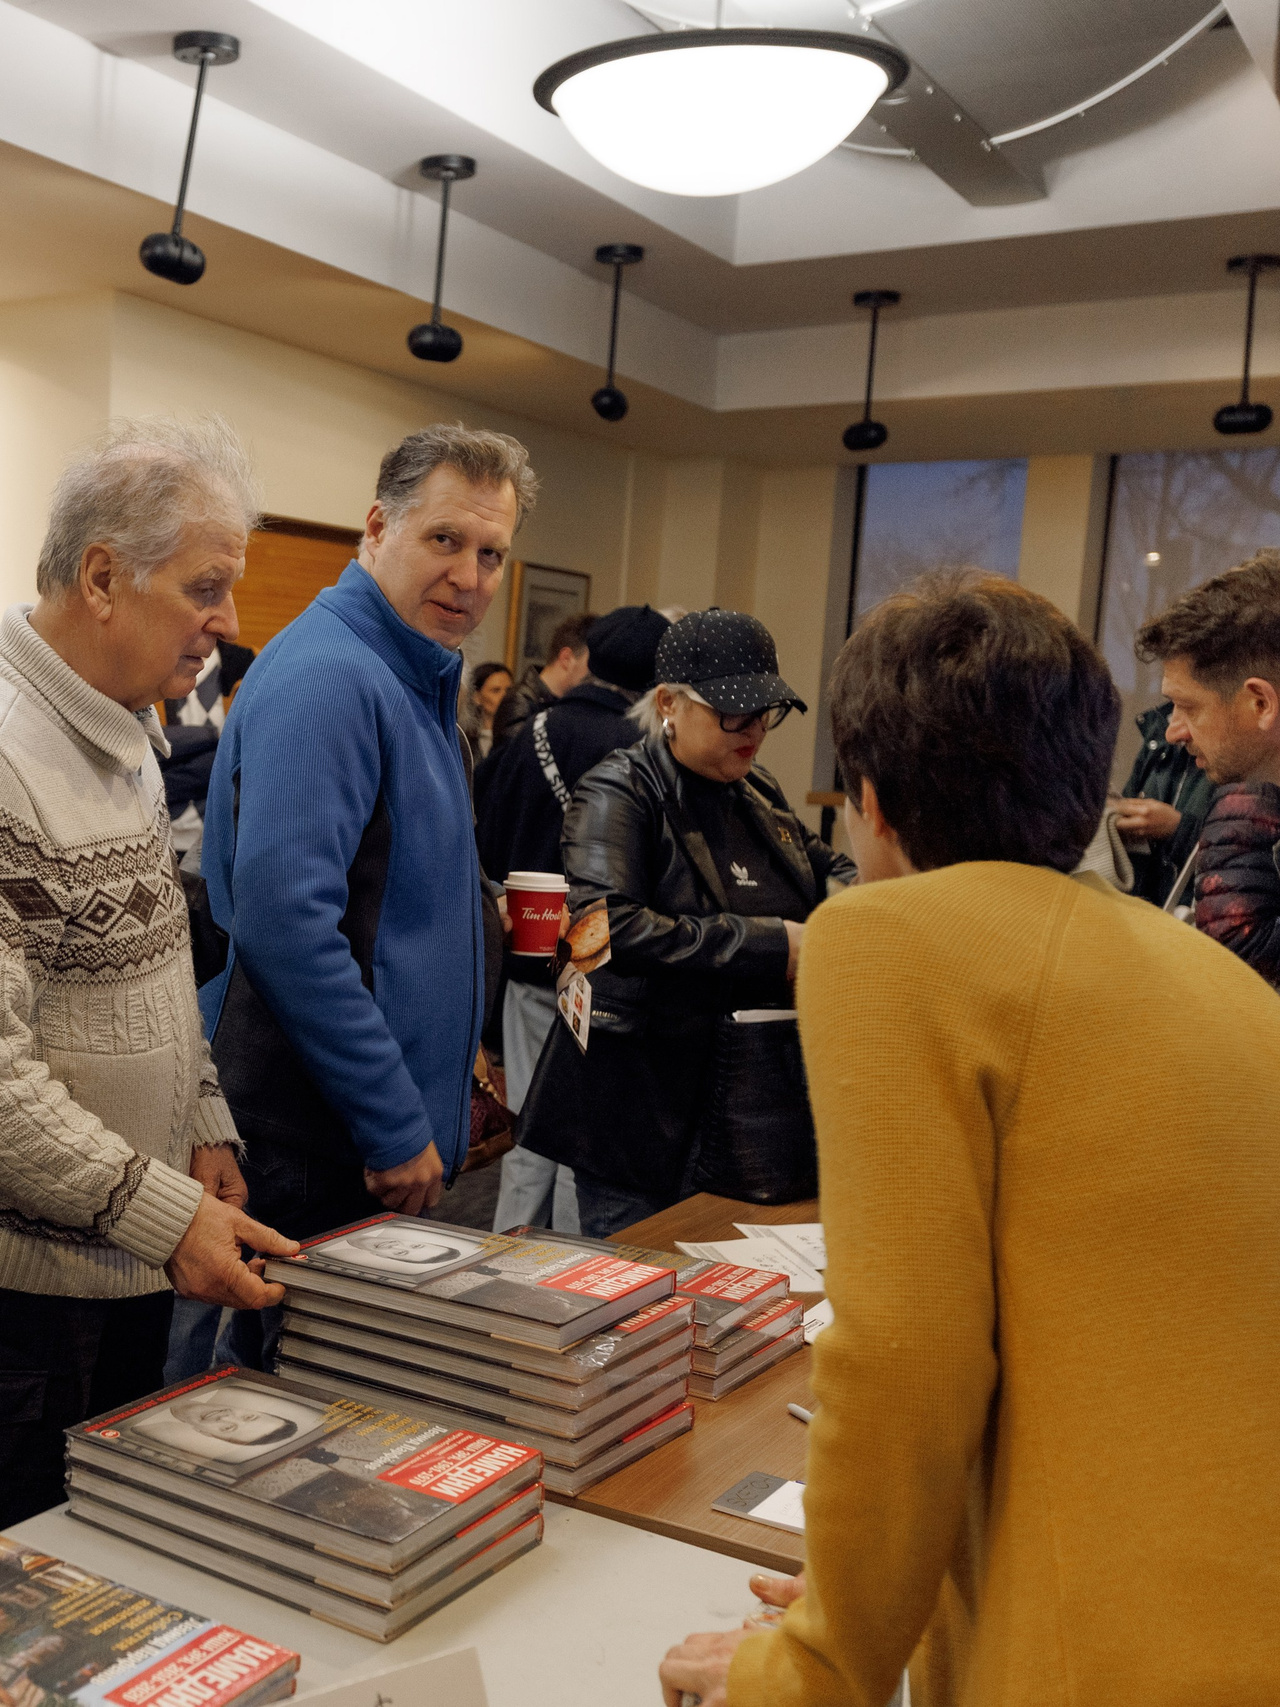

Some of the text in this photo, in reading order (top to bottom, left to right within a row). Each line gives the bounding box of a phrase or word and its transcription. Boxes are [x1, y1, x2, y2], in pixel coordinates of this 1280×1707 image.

[521, 907, 541, 921] Tim
[584, 1264, 664, 1298] НАМЕДНИ
[718, 1270, 780, 1300] НАМЕДНИ
[404, 1425, 448, 1446] Леонид
[469, 1438, 492, 1453] НАША
[430, 1444, 528, 1498] НАМЕДНИ
